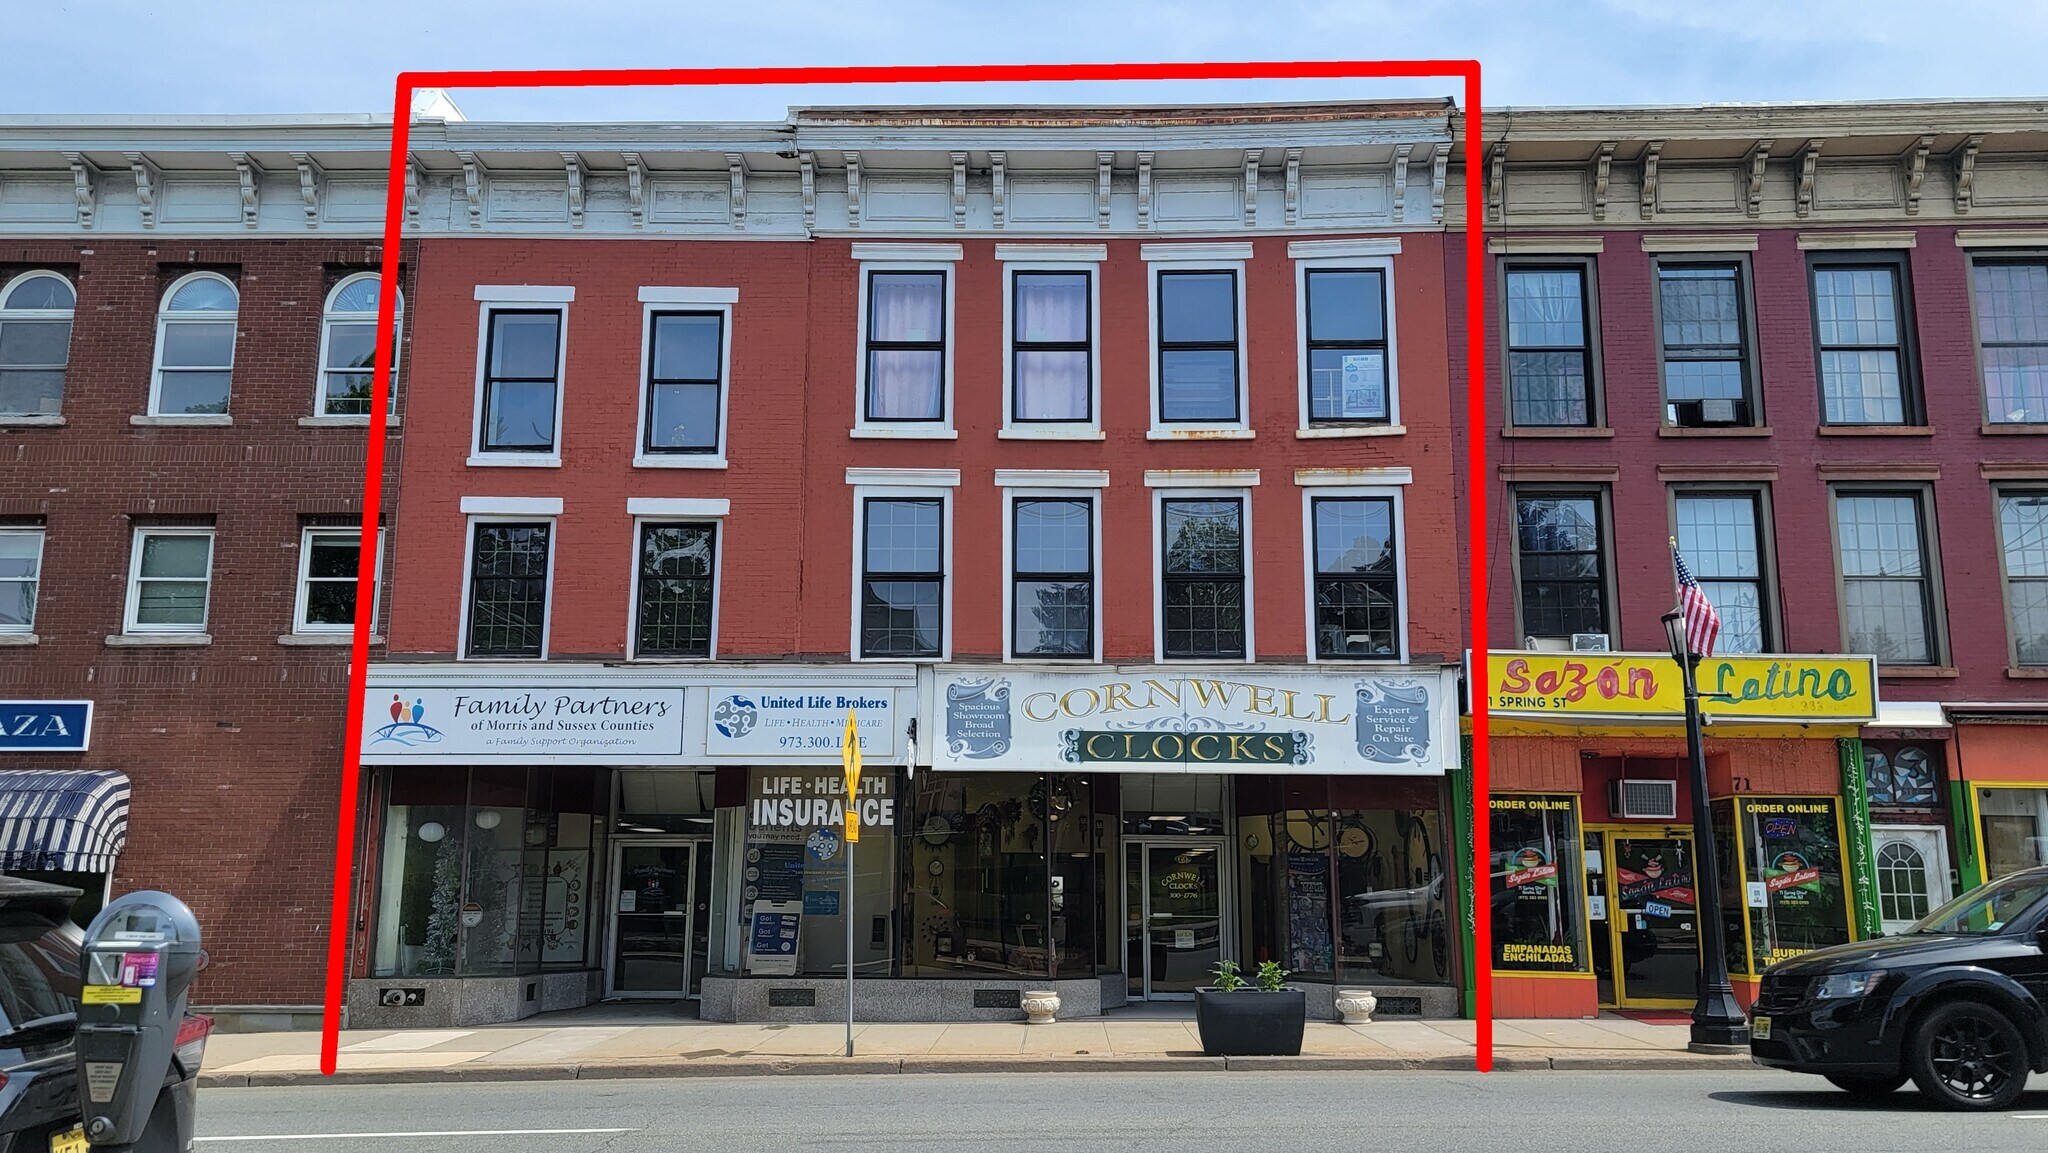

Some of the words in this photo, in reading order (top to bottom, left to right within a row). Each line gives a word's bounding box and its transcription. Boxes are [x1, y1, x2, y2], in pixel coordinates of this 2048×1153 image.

[1500, 657, 1659, 702] Sazón
[1707, 662, 1857, 705] Latino
[455, 694, 546, 720] Family
[554, 695, 672, 717] Partners
[761, 696, 804, 709] United
[808, 696, 832, 709] Life
[836, 696, 888, 709] Brokers
[958, 702, 1000, 712] Spacious
[1021, 679, 1351, 725] CORNWELL
[1500, 696, 1546, 708] SPRING
[1553, 697, 1568, 708] ST
[953, 711, 1005, 720] Showroom
[1374, 706, 1411, 716] Expert
[471, 719, 484, 731] of
[486, 719, 528, 731] Morris
[531, 719, 555, 731] and
[558, 720, 597, 731] Sussex
[600, 719, 655, 731] Counties
[792, 718, 829, 728] HEALTH
[836, 718, 883, 728] MICARE
[965, 720, 994, 729] Broad
[1366, 715, 1405, 724] Service
[1408, 715, 1419, 724] &
[957, 729, 1001, 738] Selection
[1374, 724, 1411, 734] Repair
[496, 737, 529, 747] Family
[530, 737, 567, 748] Support
[568, 737, 637, 748] Organization
[779, 736, 867, 748] 973.300.LE
[1372, 734, 1389, 743] On
[1393, 734, 1415, 743] Site
[1086, 734, 1285, 761] CLOCKS
[762, 776, 803, 795] LIFE
[1733, 777, 1751, 790] 71
[1489, 800, 1526, 809] ORDER
[1529, 801, 1570, 810] ONLINE
[1746, 804, 1784, 813] ORDER
[1787, 804, 1829, 813] ONLINE
[1766, 822, 1796, 836] OPEN
[765, 833, 780, 841] may
[781, 833, 802, 841] need.
[1161, 872, 1206, 887] CORNWELL
[1792, 871, 1816, 882] Latino
[1648, 904, 1670, 916] OPEN
[1504, 944, 1572, 954] EMPANADAS
[1503, 952, 1574, 963] ENCHILADAS
